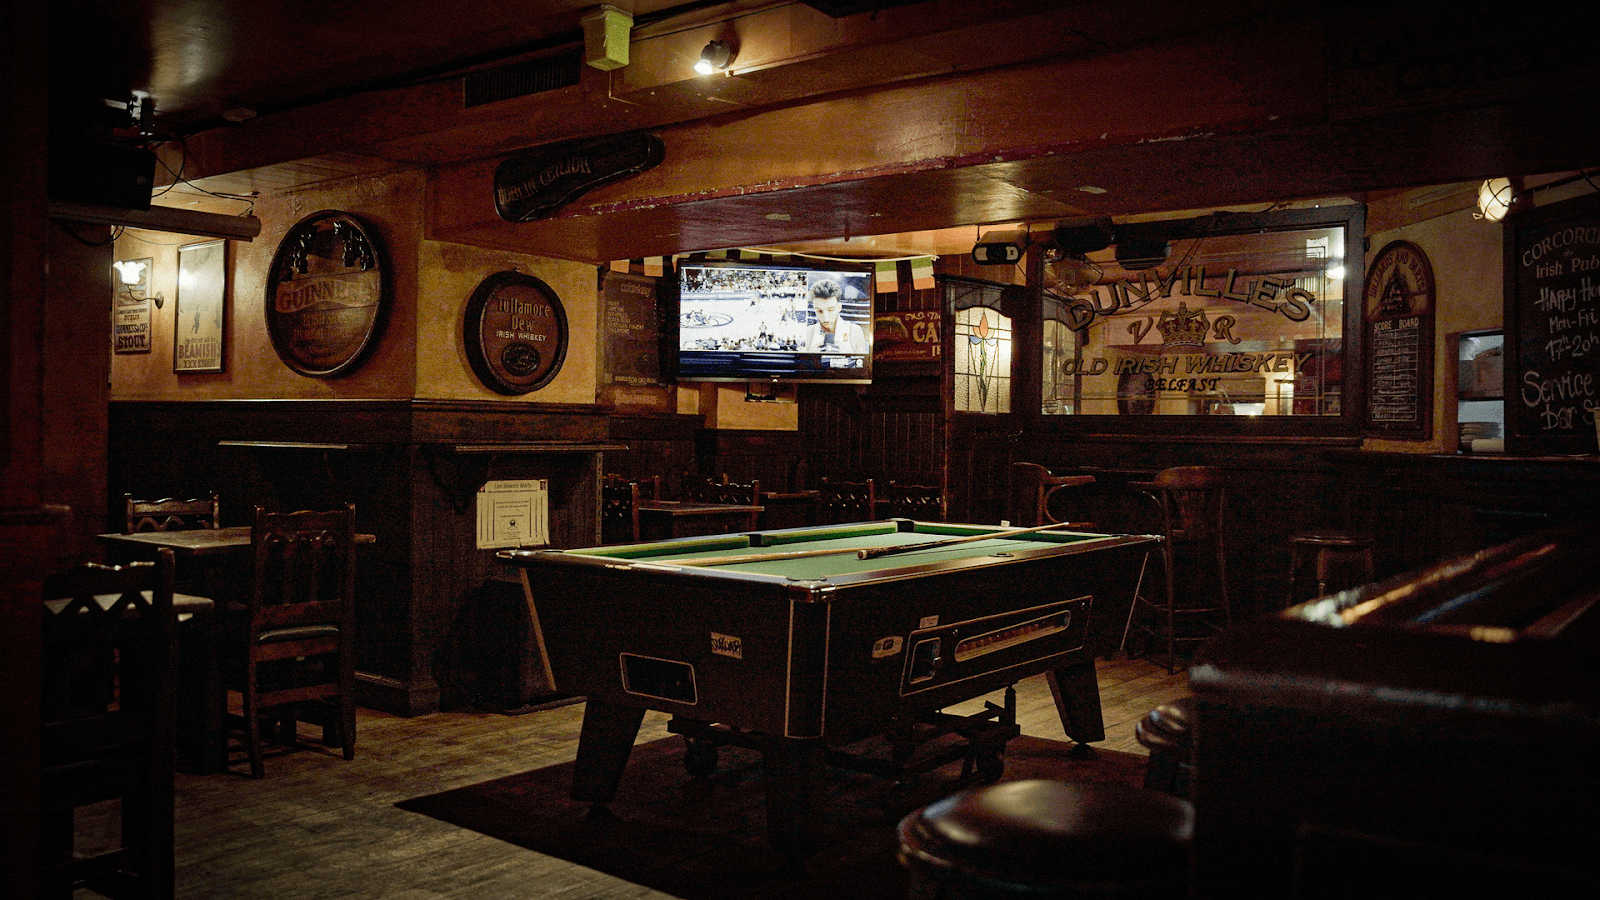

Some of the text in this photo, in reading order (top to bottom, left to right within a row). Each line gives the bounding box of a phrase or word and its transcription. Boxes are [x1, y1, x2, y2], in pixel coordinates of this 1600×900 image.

[1394, 249, 1409, 264] AND
[1409, 251, 1426, 291] DARTS
[1536, 255, 1600, 279] Irish Pub
[498, 297, 550, 318] Tullamore
[1063, 264, 1316, 332] DUNVILLE'S
[511, 315, 535, 330] Dew
[912, 321, 941, 344] CA
[1127, 315, 1241, 346] V R
[1374, 317, 1419, 332] SCORE BOARD
[118, 334, 145, 349] STOUT
[496, 331, 547, 342] IRISH WHISKEY
[178, 343, 217, 359] BEAMISH
[1062, 352, 1313, 376] OLD IRISH WHISKEY
[1145, 377, 1221, 392] BELFAST
[1521, 370, 1595, 408] Service
